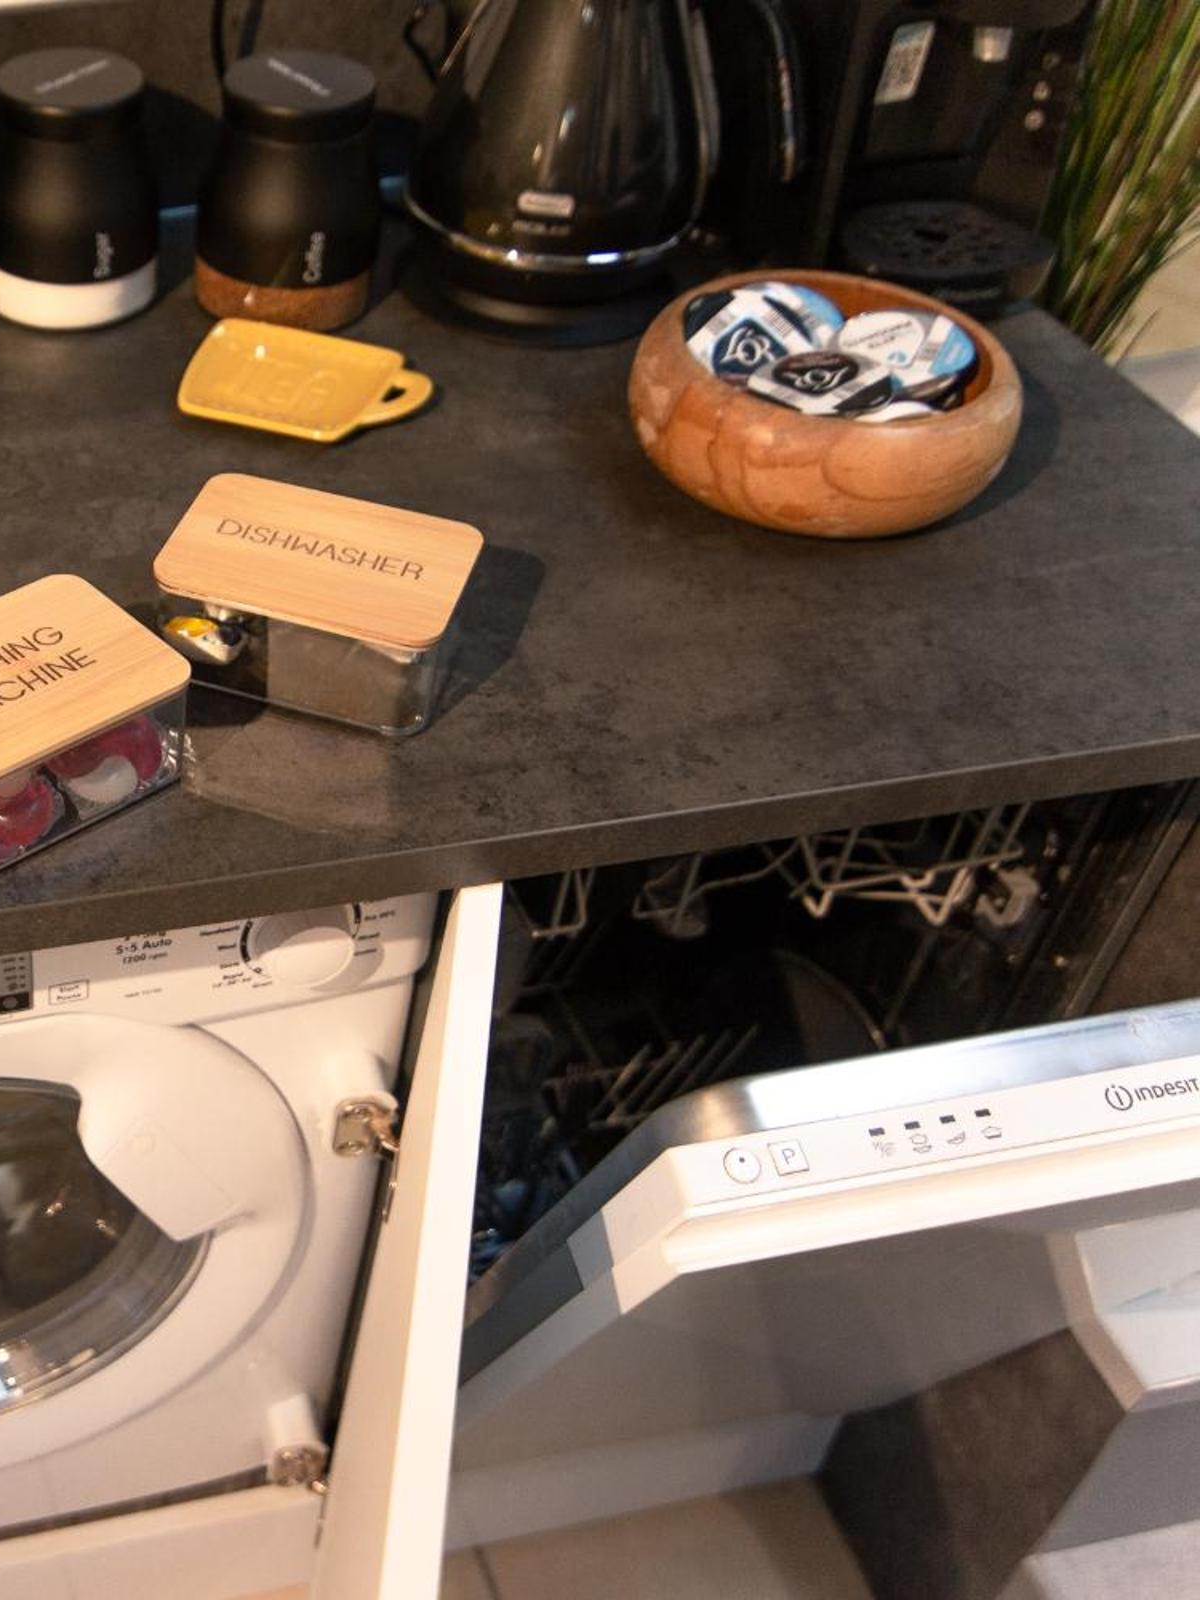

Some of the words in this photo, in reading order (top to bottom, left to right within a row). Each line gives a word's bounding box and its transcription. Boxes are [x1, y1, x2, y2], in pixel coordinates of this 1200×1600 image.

[93, 231, 114, 279] Sugar
[302, 231, 326, 284] Coffee
[216, 518, 424, 580] DISHWASHER
[781, 1147, 796, 1165] P
